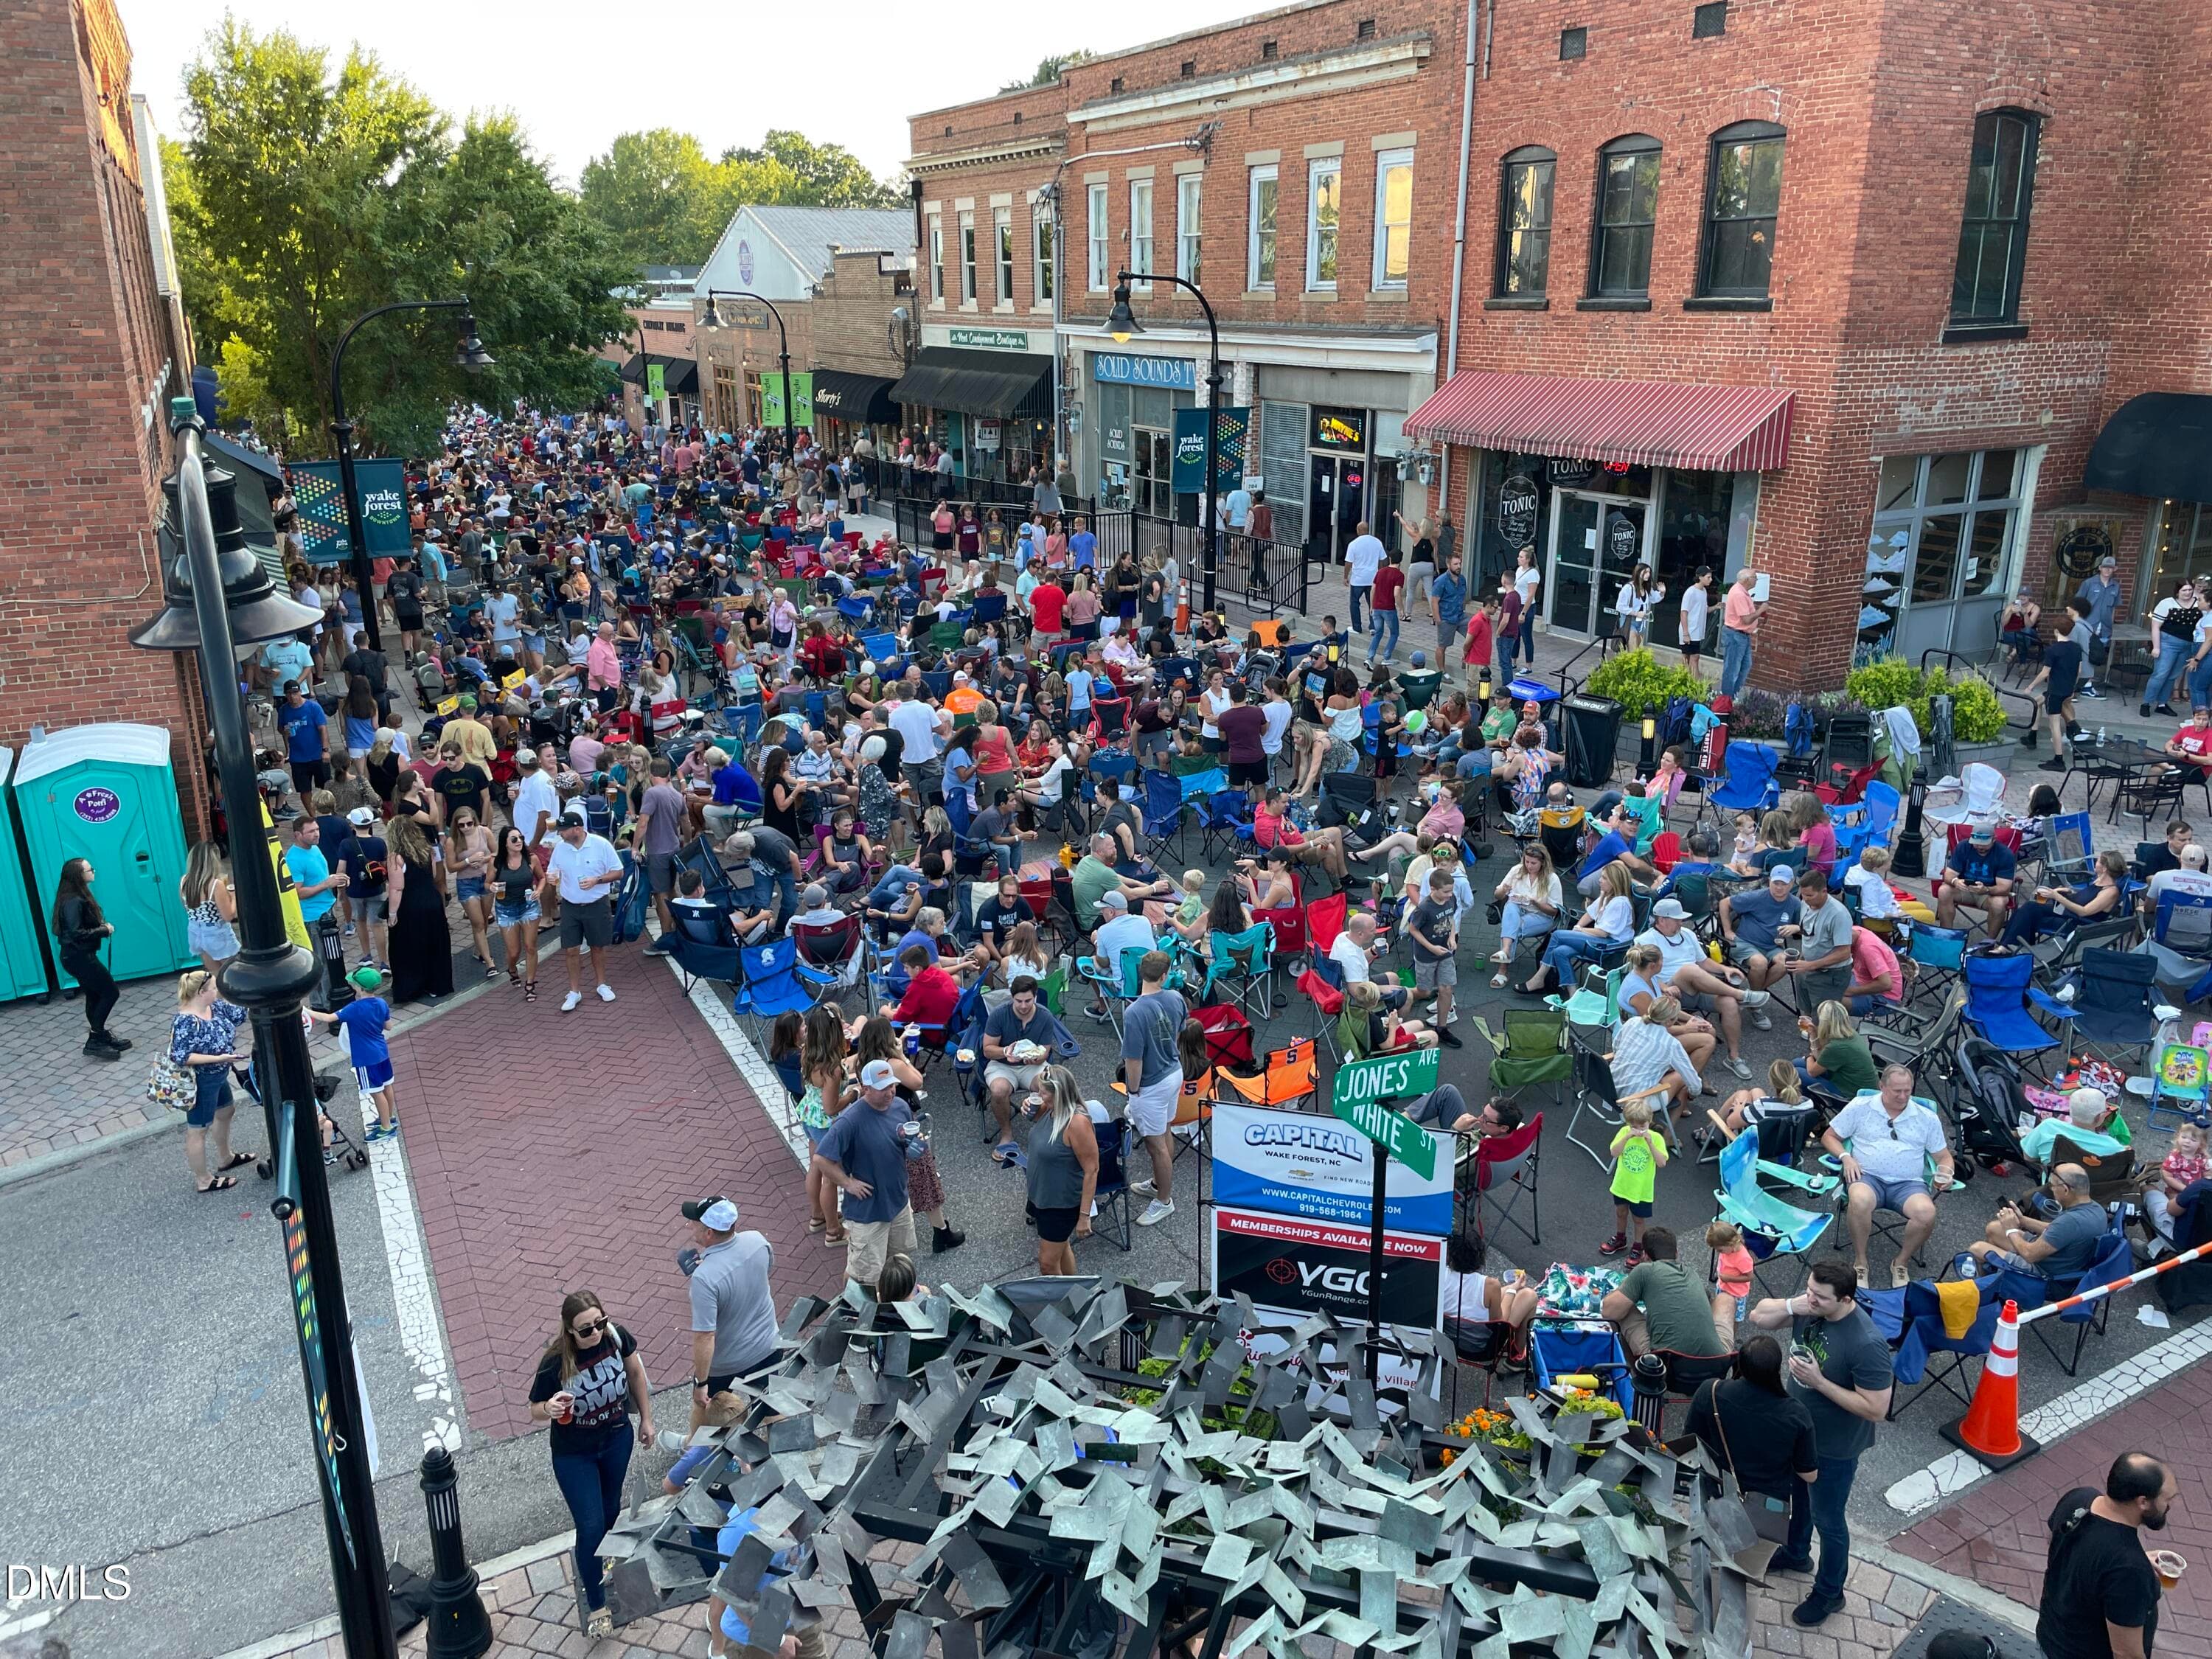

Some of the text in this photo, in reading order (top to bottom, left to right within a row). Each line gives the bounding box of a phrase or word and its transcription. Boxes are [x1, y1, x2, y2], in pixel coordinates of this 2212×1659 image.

[1097, 355, 1130, 379] SOLID
[1133, 357, 1180, 384] SOUNDS
[815, 389, 841, 408] Shorty's
[1109, 428, 1123, 439] SOLID
[1180, 434, 1204, 444] wake
[1175, 443, 1204, 458] forest
[1551, 459, 1593, 474] TONIC
[365, 490, 400, 501] wake
[362, 500, 403, 518] forest
[1503, 495, 1535, 515] TONIC
[369, 515, 401, 526] DOWNTOWN
[1614, 530, 1634, 541] TONIC
[1573, 700, 1590, 708] TRASH
[92, 790, 114, 801] Fresh
[1286, 1048, 1298, 1065] S
[1340, 1060, 1410, 1102] JONES
[1418, 1050, 1438, 1068] AVE
[1184, 1082, 1198, 1096] S
[1352, 1104, 1436, 1153] WHITE ST
[1245, 1124, 1363, 1163] CAPITAL
[1265, 1150, 1290, 1159] WAKE
[1293, 1154, 1327, 1165] FOREST,
[1262, 1187, 1401, 1214] WWW.CAPITALCHEVROLECOM
[1299, 1204, 1362, 1220] 919-568-1964
[1231, 1219, 1427, 1254] MEMBERSHIPS AVAILAE NOW
[1301, 1290, 1370, 1305] YGunRange.co
[1385, 1375, 1418, 1389] Villag
[573, 1371, 627, 1416] DMC
